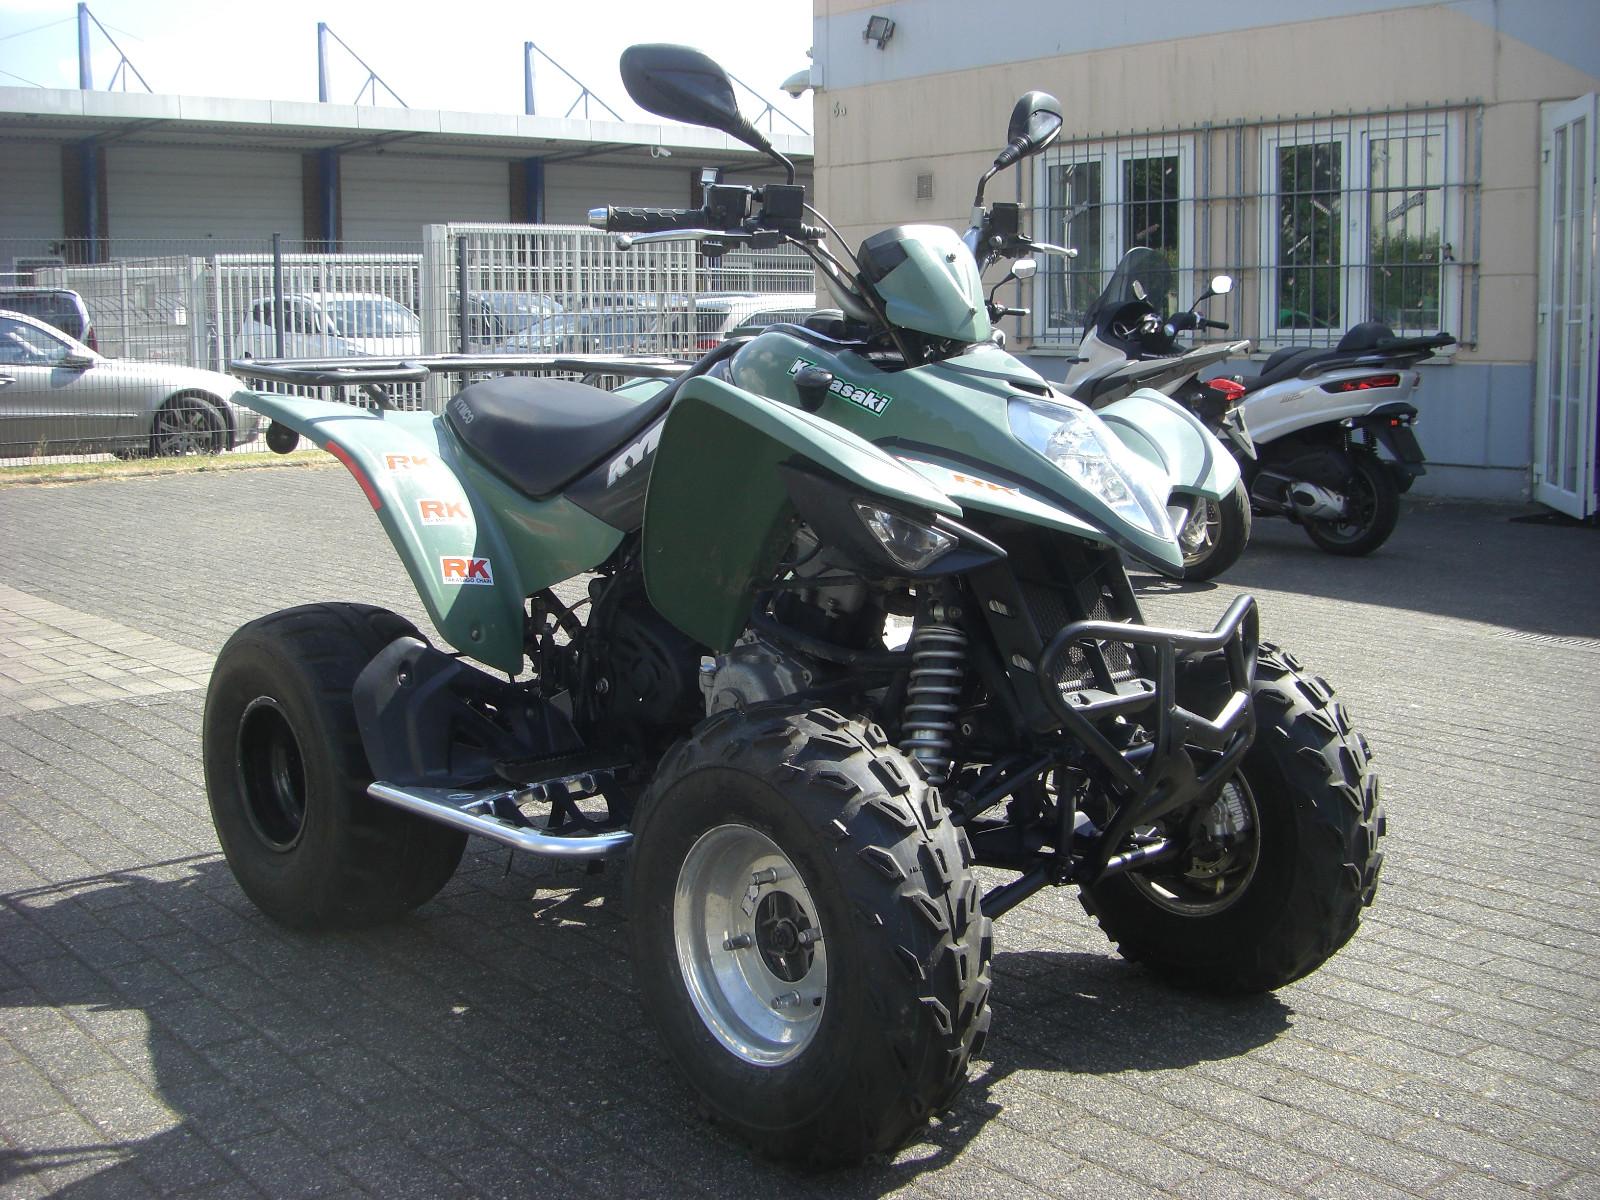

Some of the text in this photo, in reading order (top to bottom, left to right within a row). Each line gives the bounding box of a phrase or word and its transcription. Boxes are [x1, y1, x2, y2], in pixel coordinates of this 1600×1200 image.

[789, 357, 891, 414] Kasaki
[420, 501, 468, 518] RK
[443, 559, 490, 578] RK
